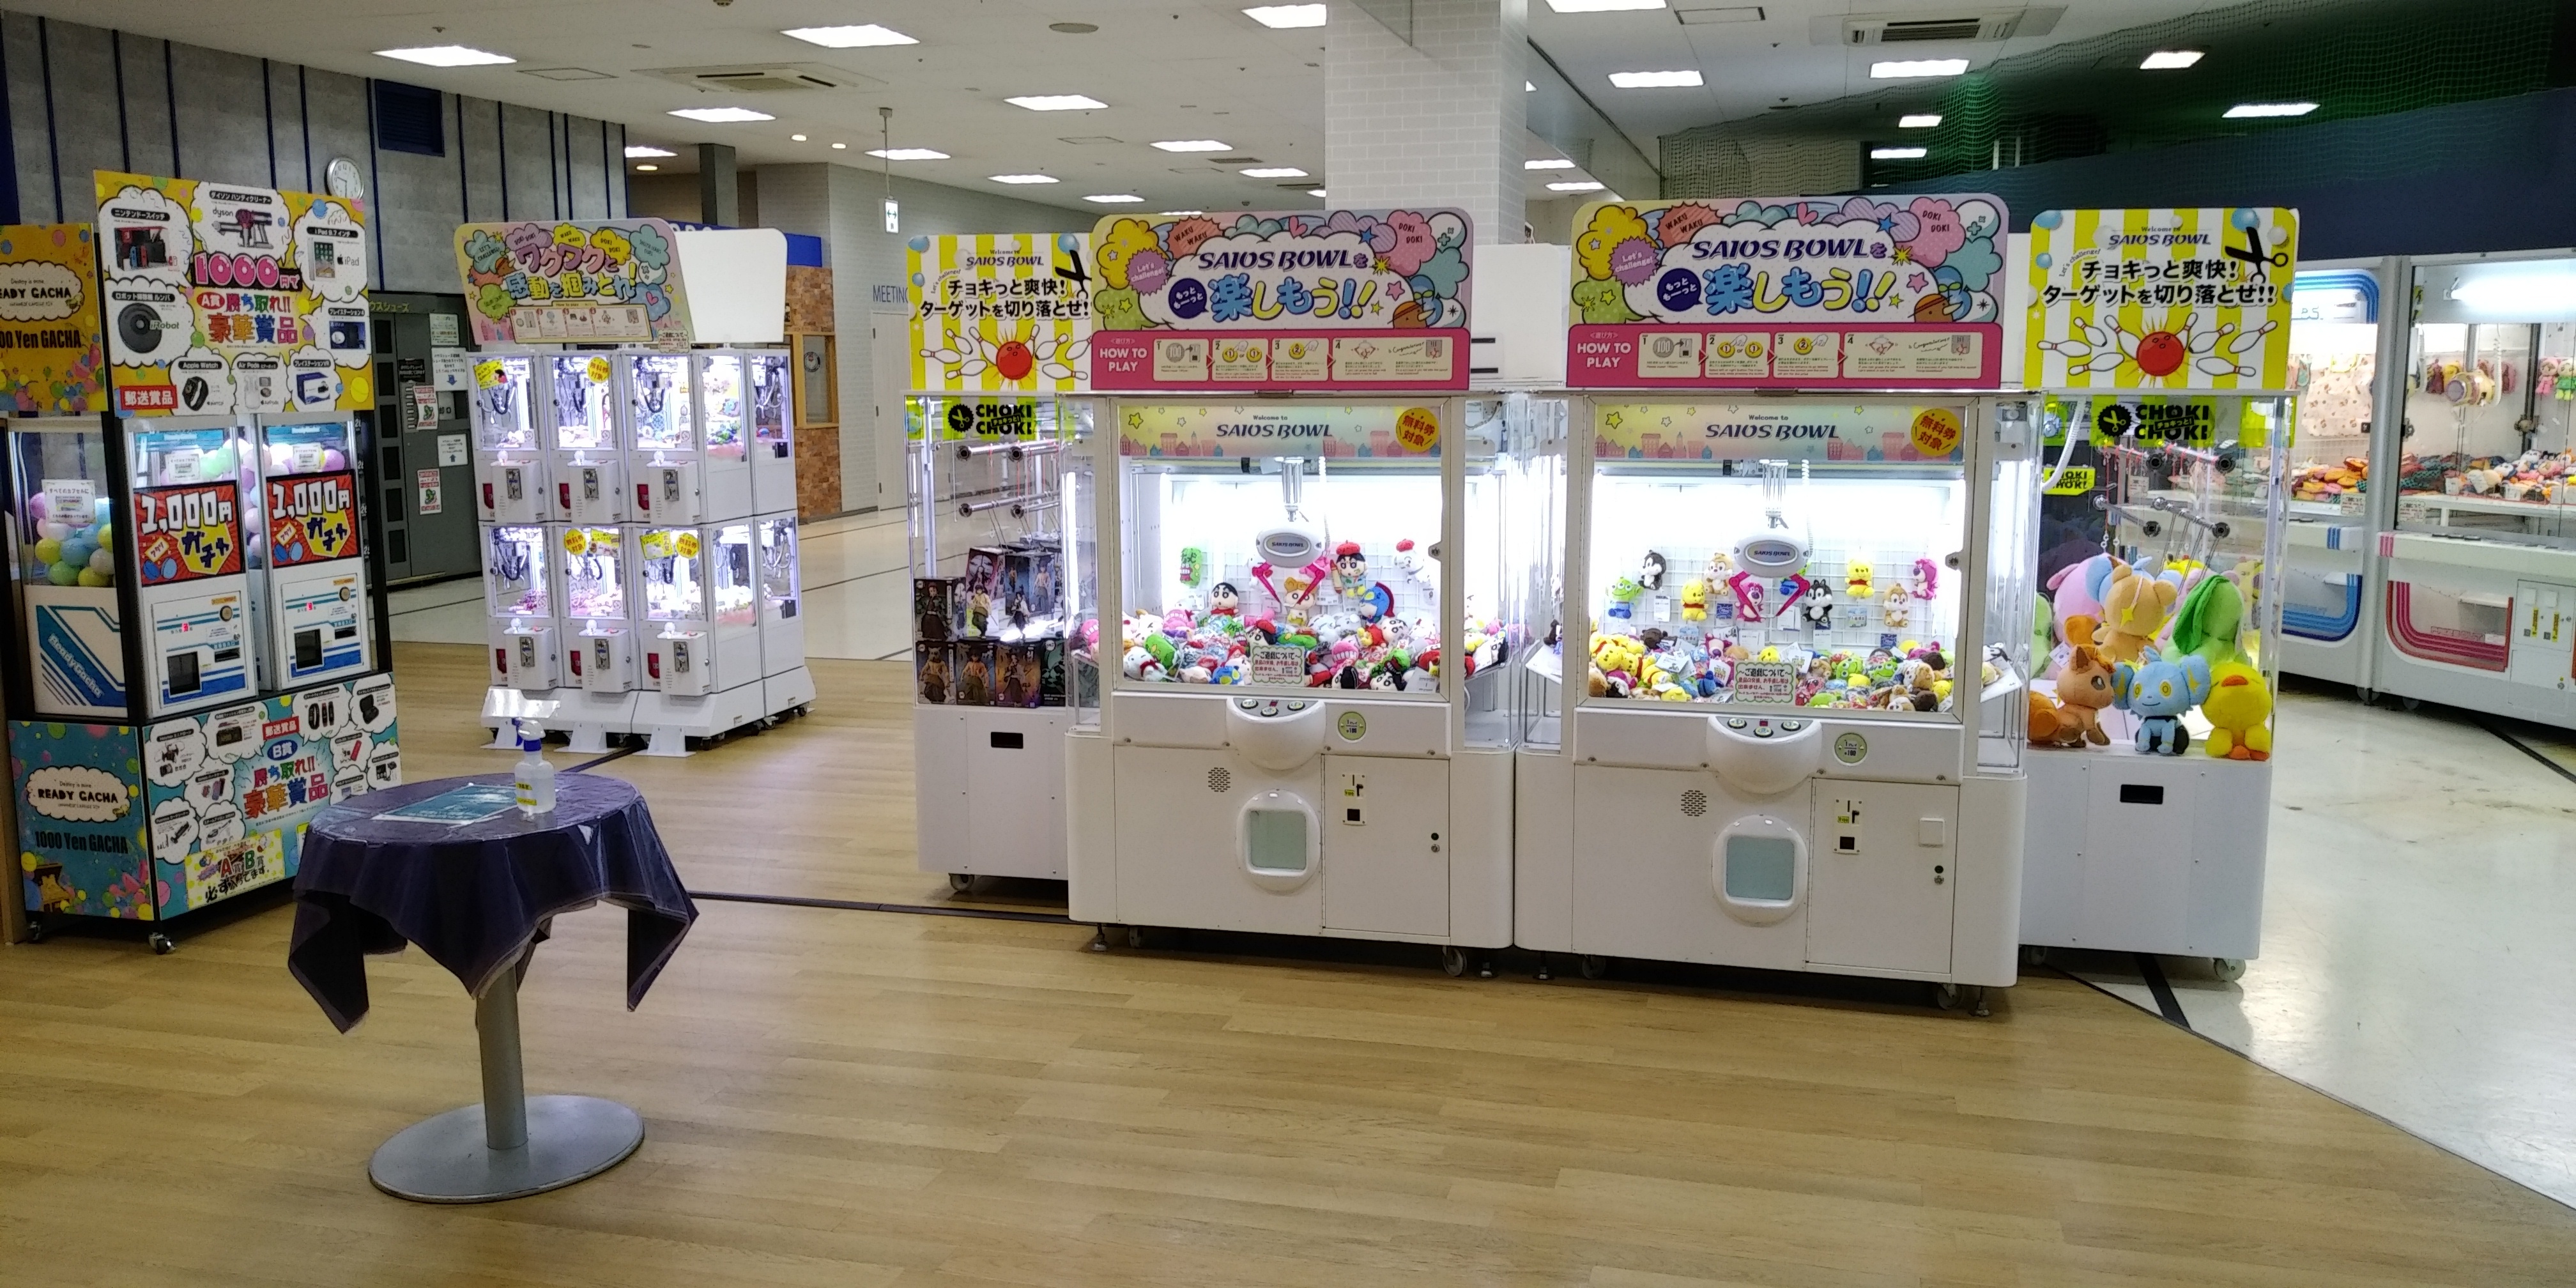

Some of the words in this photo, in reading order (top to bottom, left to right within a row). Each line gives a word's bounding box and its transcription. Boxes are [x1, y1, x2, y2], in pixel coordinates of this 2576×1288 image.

[213, 207, 234, 217] dyson
[1922, 210, 1941, 221] DOKI
[1399, 222, 1415, 233] DOKI
[1665, 213, 1688, 230] WAKU
[1680, 218, 1704, 234] WAKU
[1931, 224, 1950, 233] DOKI
[1174, 226, 1193, 243] WAKU
[1187, 232, 1208, 245] WAKU
[1406, 235, 1423, 244] DOKI
[2109, 234, 2161, 246] SAIOS
[2163, 234, 2211, 247] BOWL
[1621, 251, 1643, 263] Let's
[1692, 240, 1778, 261] SAIOS
[2069, 249, 2102, 263] challenge!
[344, 257, 360, 266] iPad
[515, 243, 620, 278] ワクワクと
[967, 256, 1005, 266] SAIOS
[1006, 256, 1045, 267] BOWL
[1137, 262, 1155, 273] Let's
[1198, 252, 1274, 270] SAIOS
[1615, 257, 1653, 273] challenge!
[194, 252, 300, 289] 1000円で
[937, 268, 962, 282] challenge!
[1131, 266, 1165, 283] challenge!
[2082, 260, 2237, 280] チョキっと爽快!
[948, 279, 1066, 296] チョキっと爽快!
[1666, 277, 1689, 291] もっと
[1703, 263, 1896, 316] 楽しもう!!
[31, 288, 71, 298] GACHA
[1176, 287, 1196, 299] もっと
[1208, 272, 1377, 323] 楽しもう!!
[1662, 284, 1698, 302] もーっと
[2043, 284, 2276, 305] ターゲットを切り落とせ!!
[201, 295, 220, 308] A賞
[1173, 293, 1204, 310] もーっと
[150, 319, 180, 331] iRobot
[208, 313, 298, 344] 豪華賞品
[15, 330, 38, 348] Yen
[41, 330, 81, 348] GACHA
[1215, 342, 1220, 351] 2
[1275, 342, 1280, 350] 3
[1657, 341, 1670, 353] 100
[1847, 336, 1854, 344] 4
[1100, 348, 1129, 359] HOW
[1131, 348, 1147, 359] TO
[1169, 345, 1182, 358] 100
[1577, 342, 1611, 354] HOW
[1614, 342, 1631, 353] TO
[1108, 361, 1138, 372] PLAY
[1586, 356, 1621, 369] PLAY
[124, 390, 173, 406] 郵送賞品
[976, 404, 1032, 417] CHOKI
[2135, 404, 2209, 420] CHOKI
[1216, 424, 1274, 438] SAIOS
[1278, 424, 1333, 440] BOWL
[1402, 415, 1436, 435] 無料券
[1705, 424, 1770, 438] SAIOS
[1775, 424, 1839, 440] BOWL
[1920, 415, 1956, 440] 無料券
[1402, 431, 1425, 447] 対象
[1918, 431, 1942, 448] 対象
[273, 479, 351, 520] 1,000円
[141, 491, 233, 535] 1,000円
[306, 517, 348, 552] ガチャ
[181, 531, 229, 569] ガチャ
[265, 720, 297, 737] 郵送賞品
[273, 742, 293, 759] B賞
[38, 788, 74, 800] READY
[79, 790, 118, 803] GACHA
[243, 772, 329, 820] 豪華賞品
[35, 831, 62, 849] 1000
[64, 832, 87, 851] Yen
[89, 834, 128, 854] GACHA
